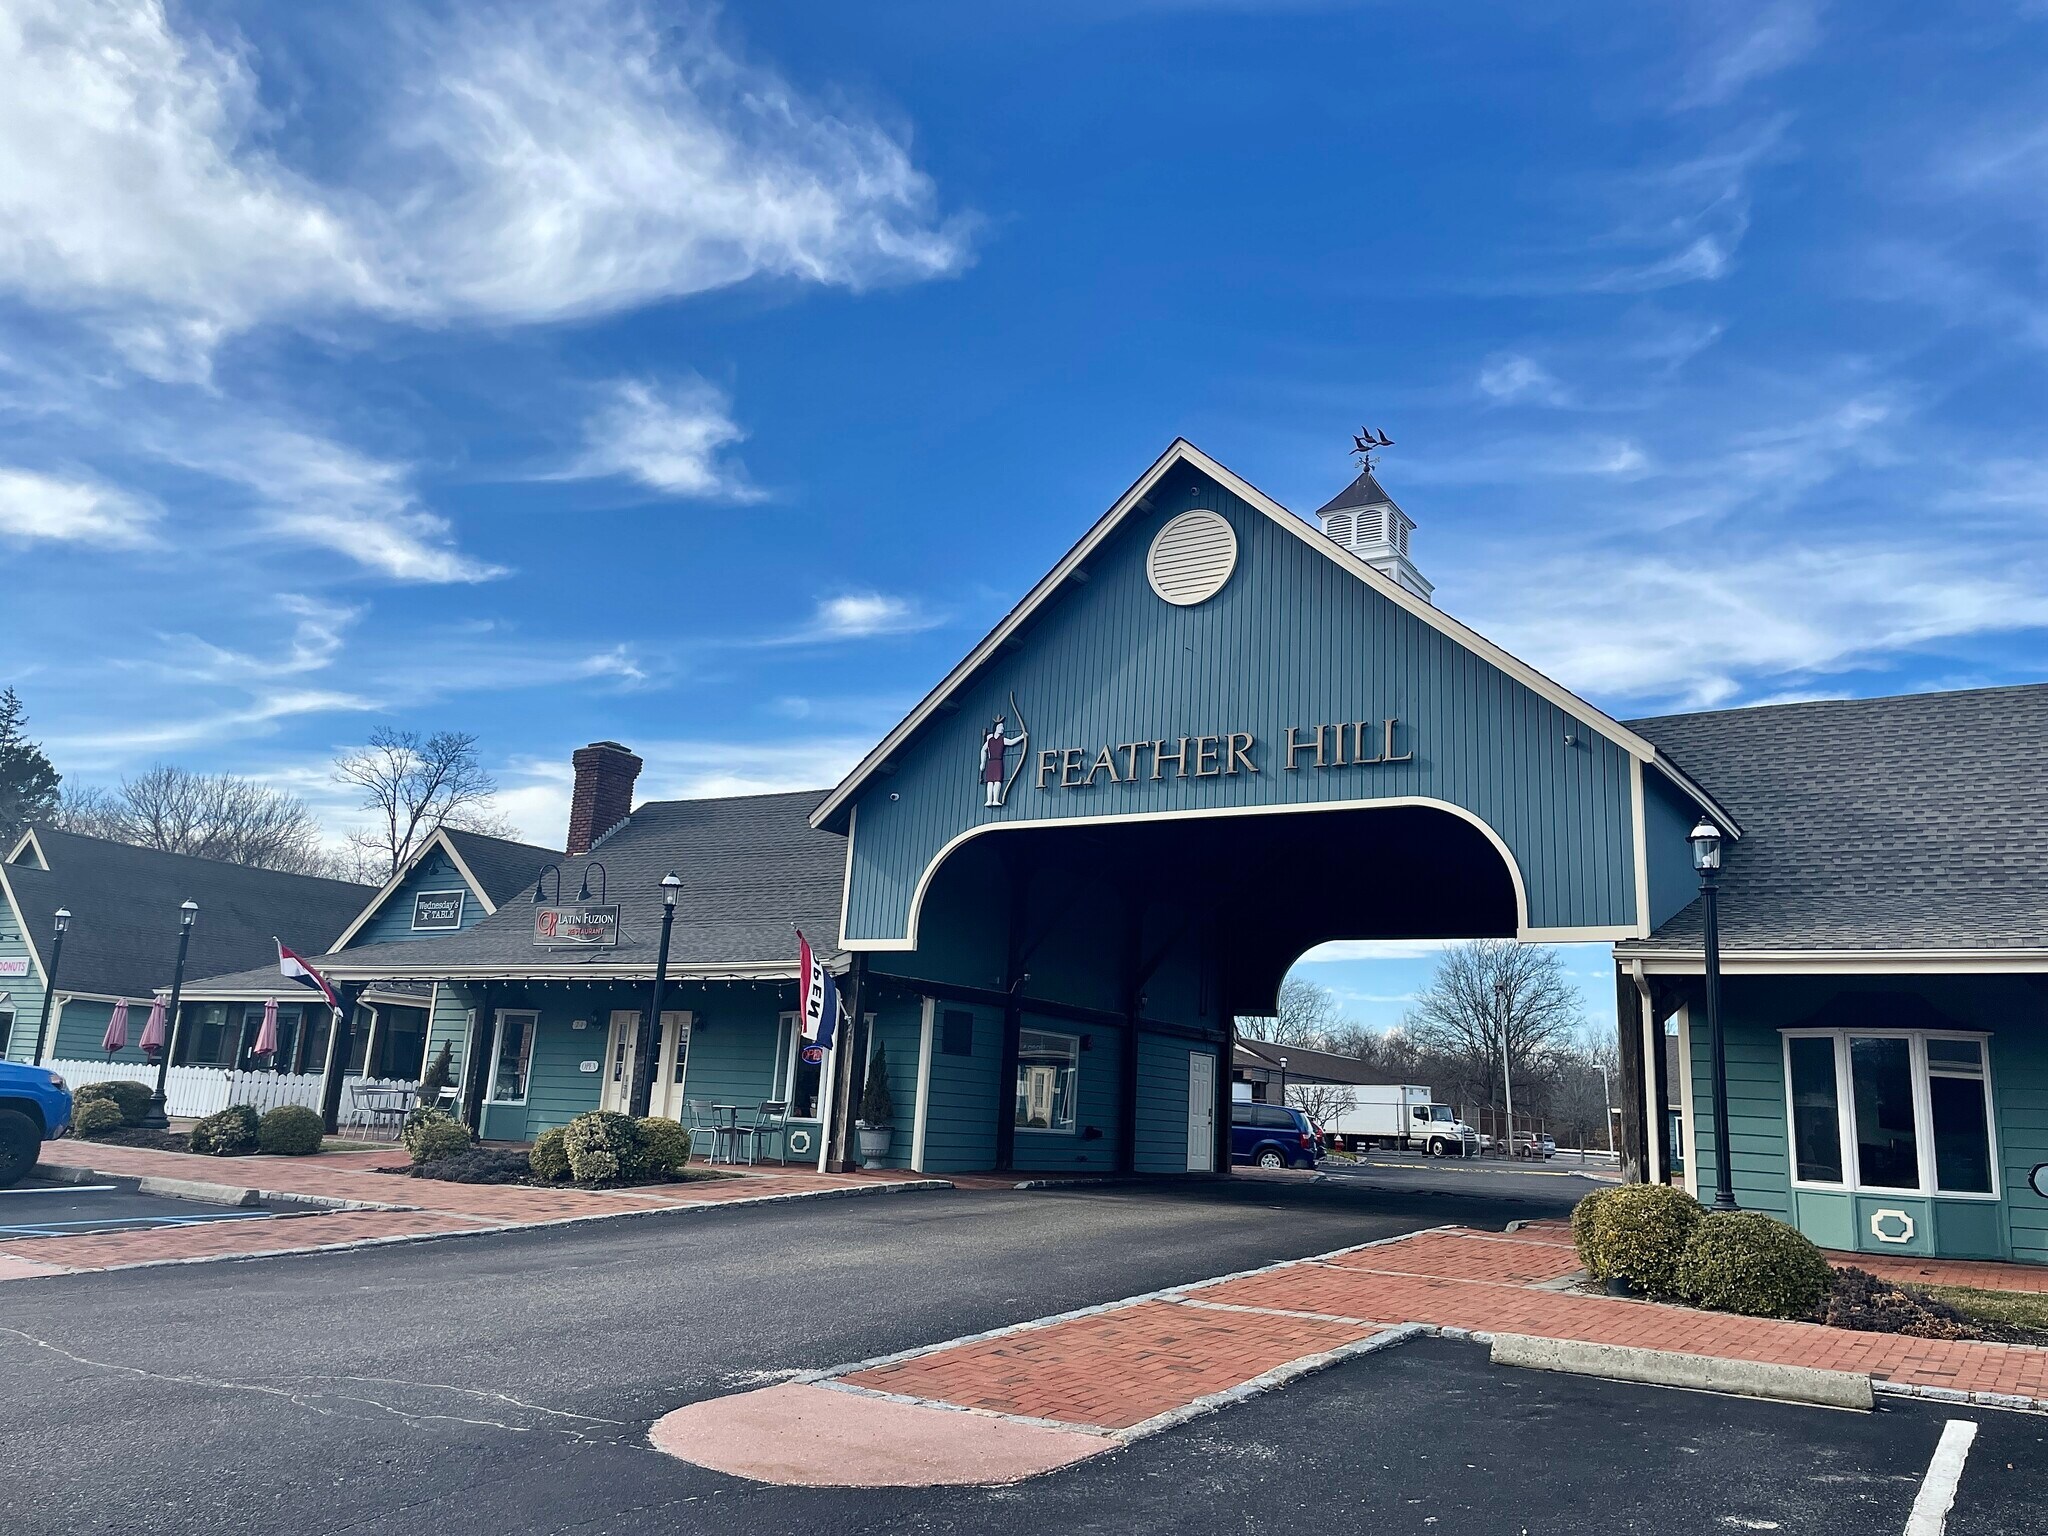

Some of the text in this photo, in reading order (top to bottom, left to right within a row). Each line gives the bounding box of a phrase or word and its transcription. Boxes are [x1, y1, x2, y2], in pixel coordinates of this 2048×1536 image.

[1035, 718, 1413, 789] FEATHER HILL
[418, 900, 459, 911] Wednesday's
[431, 910, 455, 919] TABLE
[558, 912, 614, 924] LATIN FUZION
[567, 927, 604, 936] RESTAURANT
